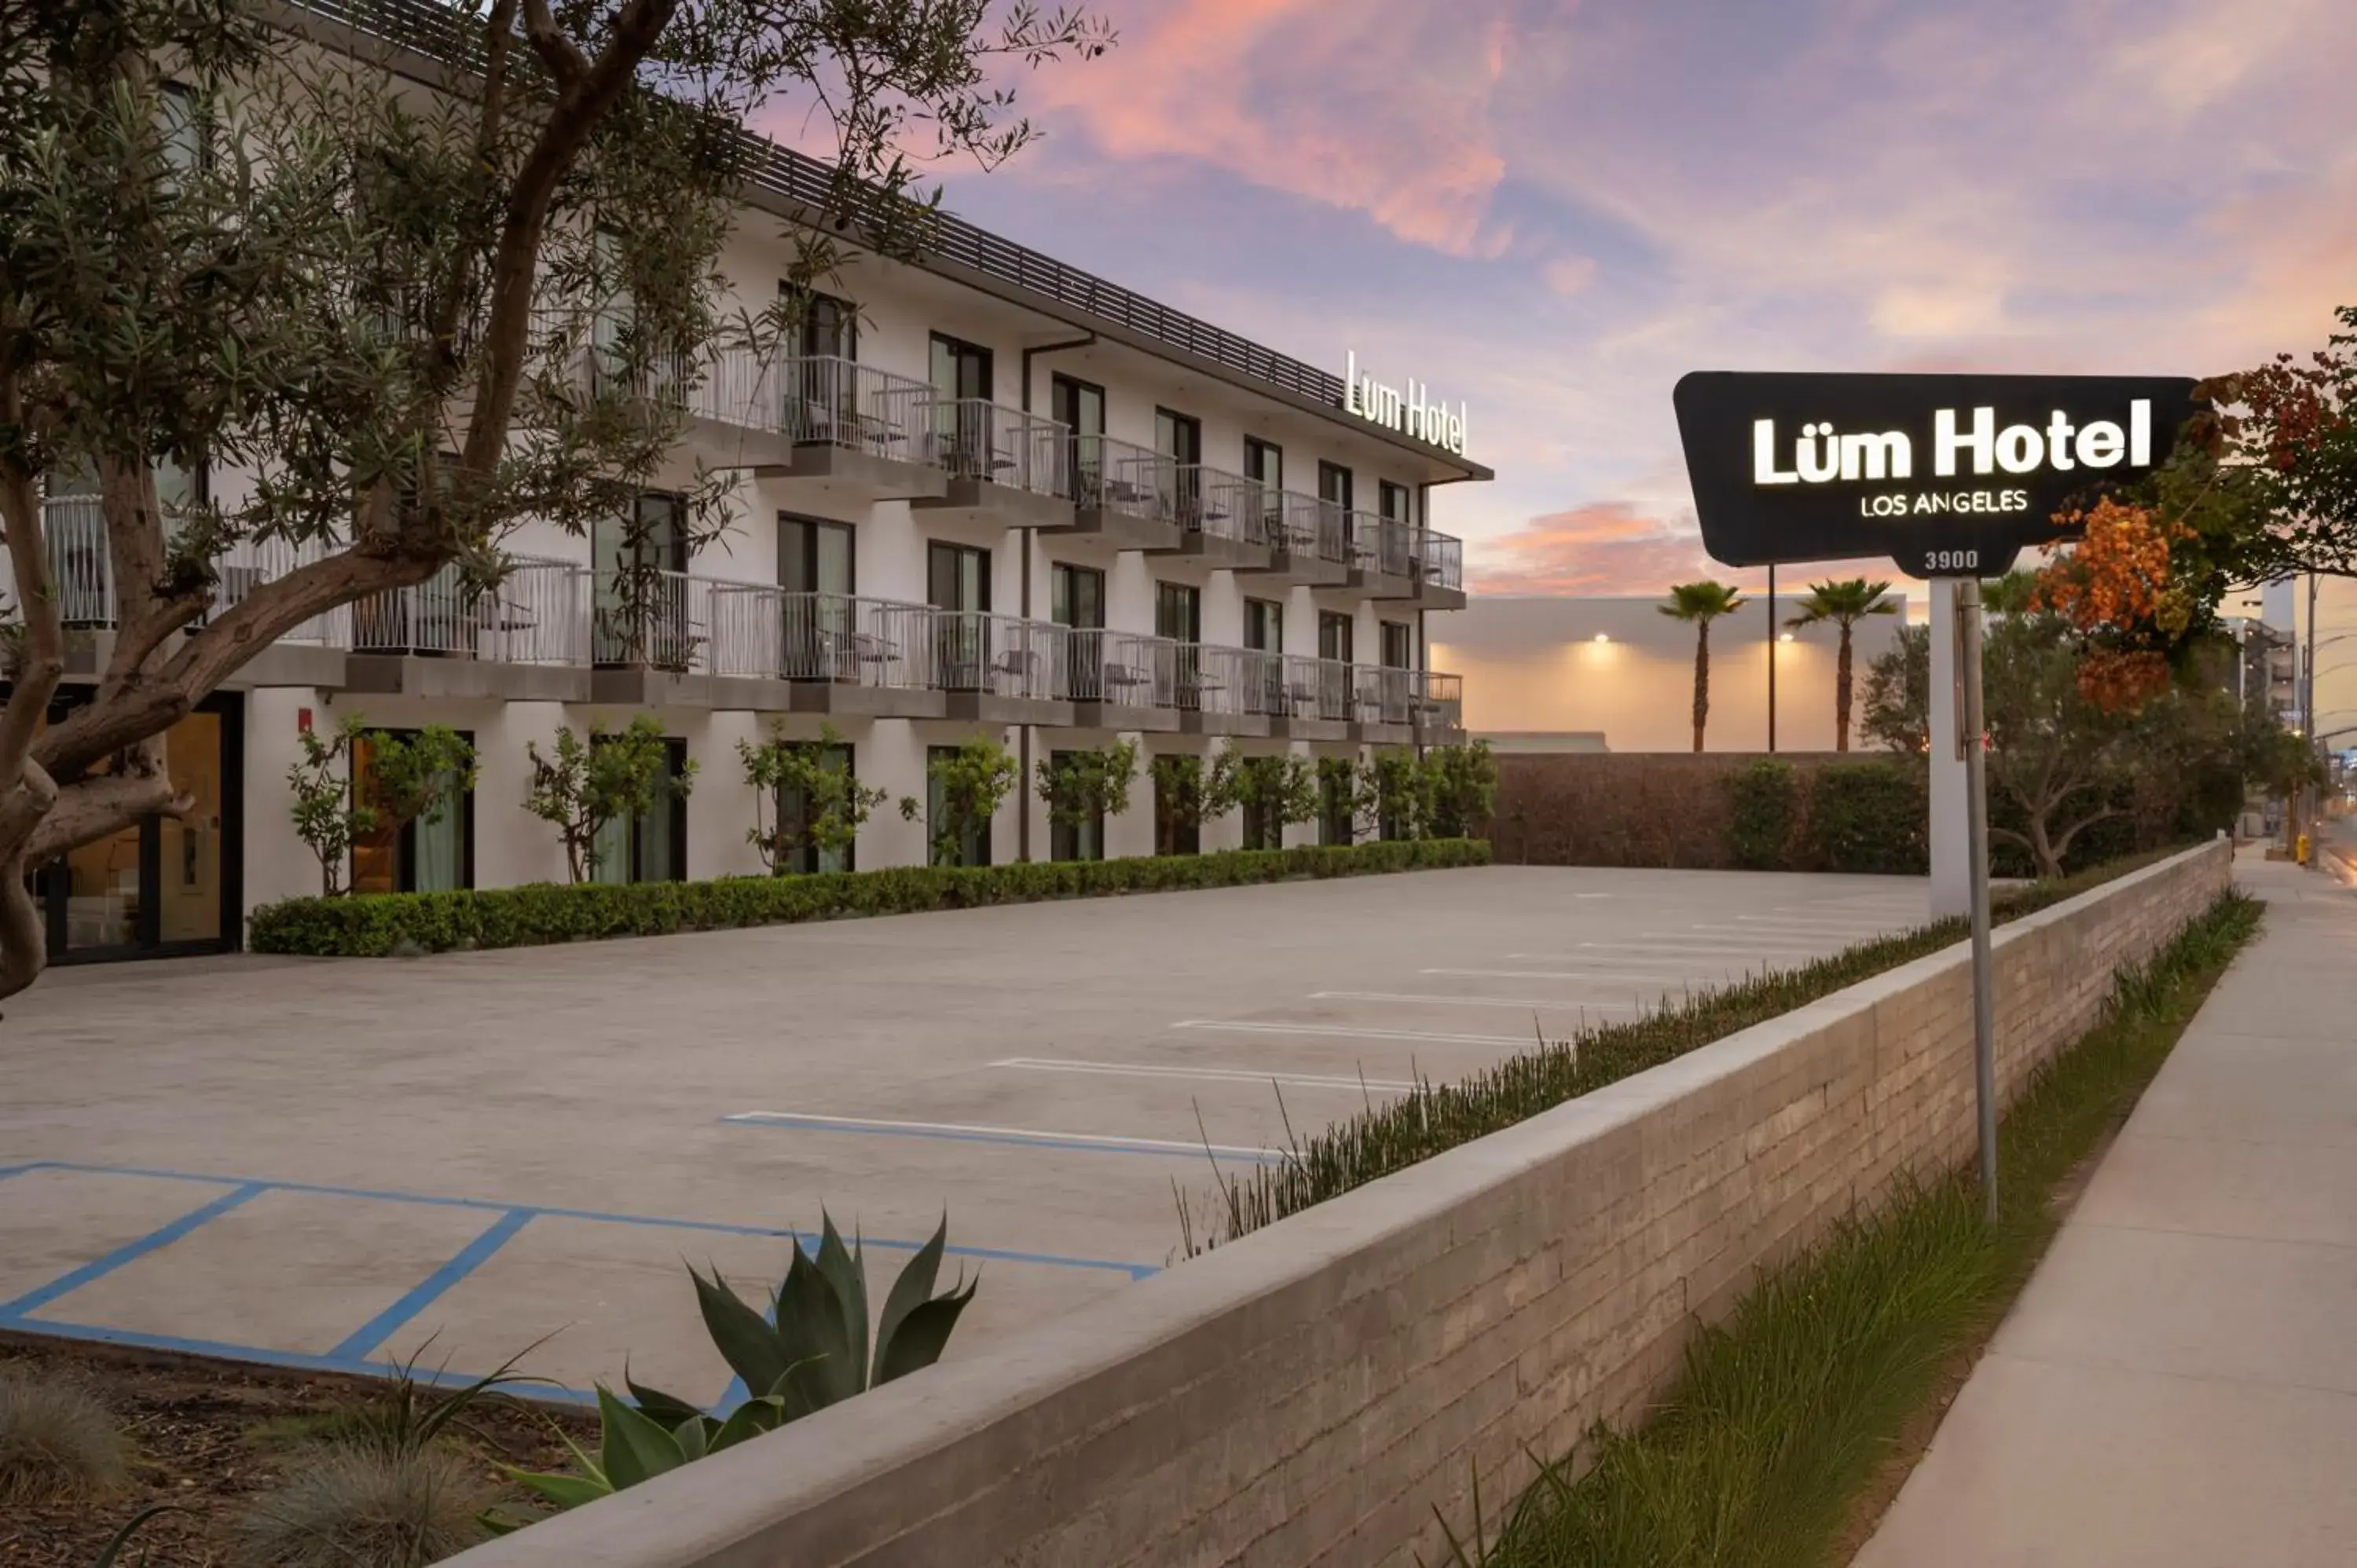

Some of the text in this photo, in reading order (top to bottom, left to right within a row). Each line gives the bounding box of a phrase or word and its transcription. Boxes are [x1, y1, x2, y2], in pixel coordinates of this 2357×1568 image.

[1406, 377, 1467, 457] Hotel
[1754, 399, 2151, 485] Lüm Hotel
[1861, 490, 2028, 517] LOS ANGELES
[1925, 551, 1978, 570] 3900
